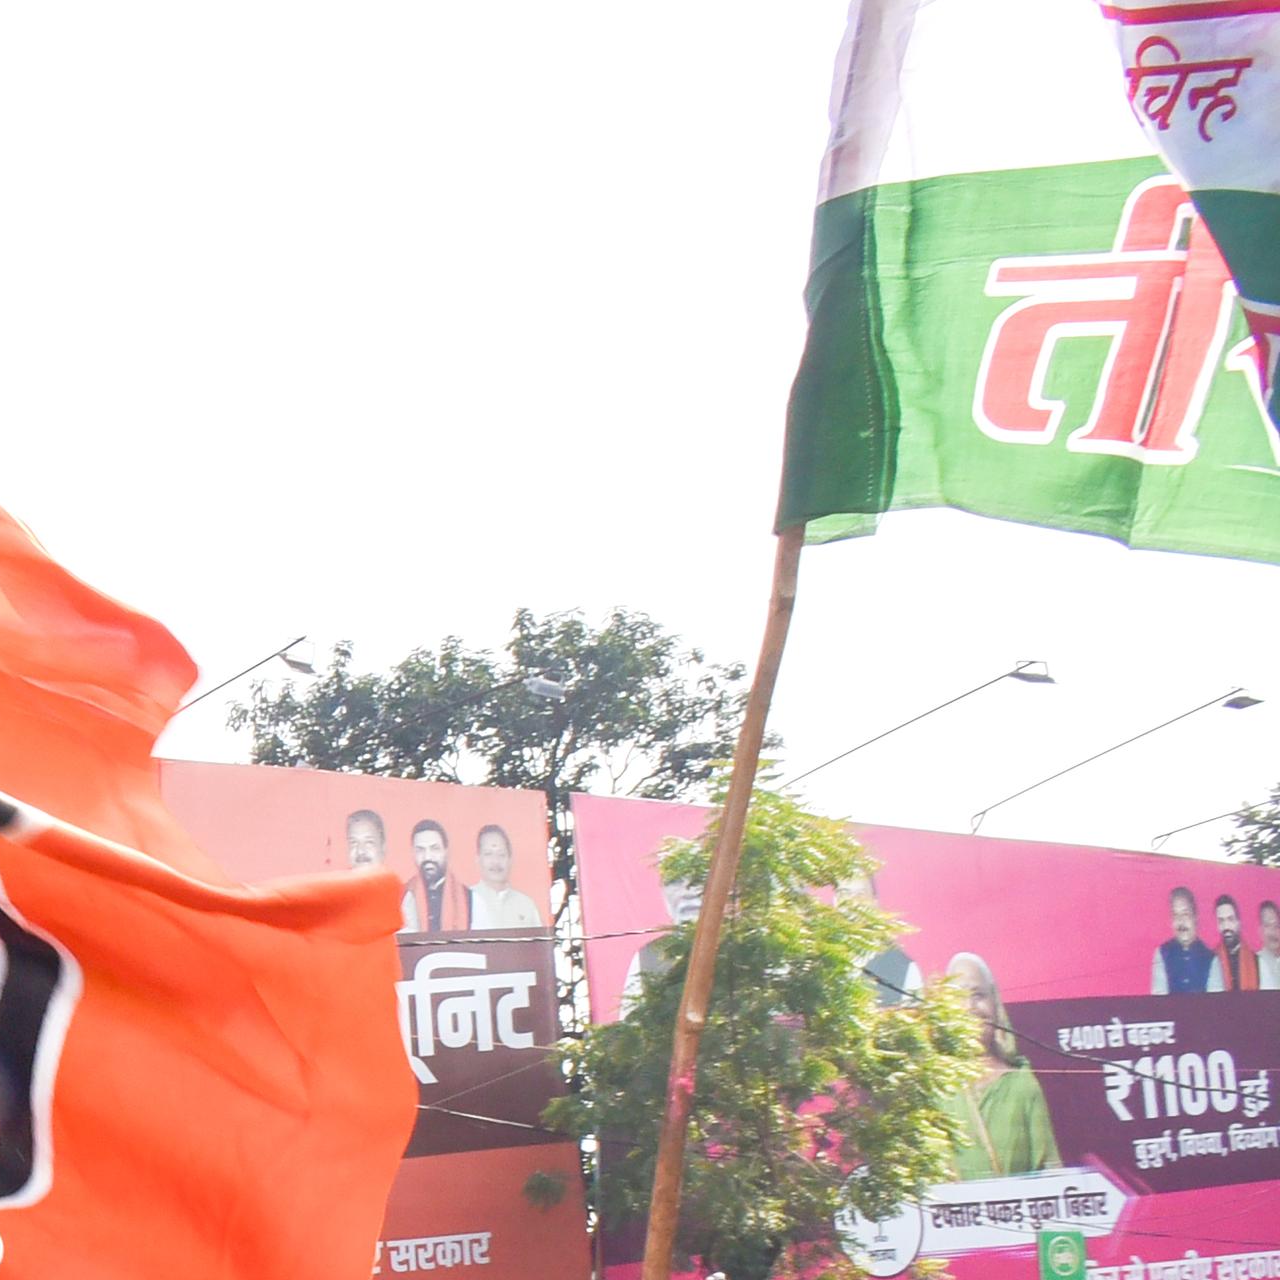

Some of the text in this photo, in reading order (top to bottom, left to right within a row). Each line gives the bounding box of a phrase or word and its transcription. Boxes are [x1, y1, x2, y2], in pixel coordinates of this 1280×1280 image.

[972, 173, 1280, 468] ती
[1105, 1017, 1125, 1048] से
[1102, 1050, 1238, 1121] ₹1100
[1062, 1186, 1109, 1219] बिहार
[386, 1231, 492, 1273] सरकार
